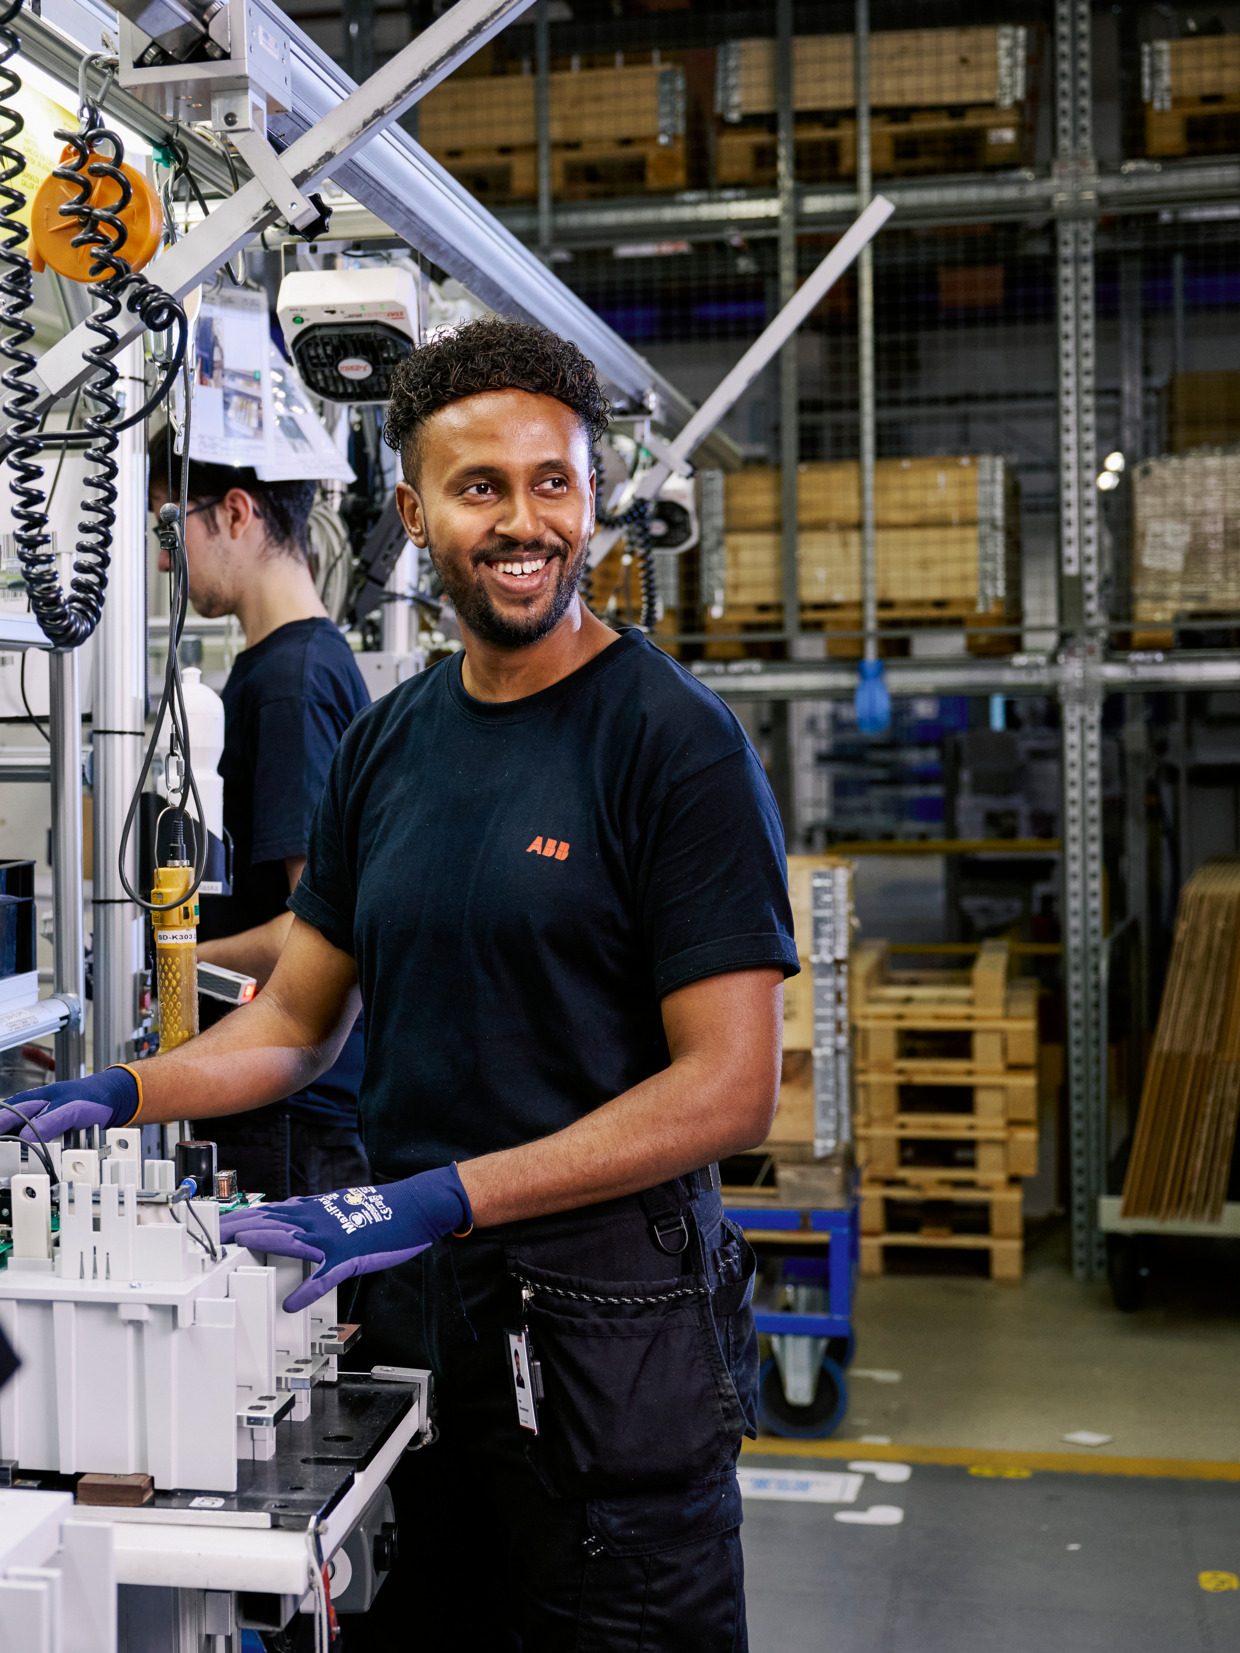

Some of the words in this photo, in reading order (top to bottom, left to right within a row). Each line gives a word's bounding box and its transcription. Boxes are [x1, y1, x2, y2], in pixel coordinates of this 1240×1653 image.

[526, 836, 570, 861] ABB
[158, 933, 193, 941] SD-K303
[317, 1197, 357, 1235] MaxiFlex
